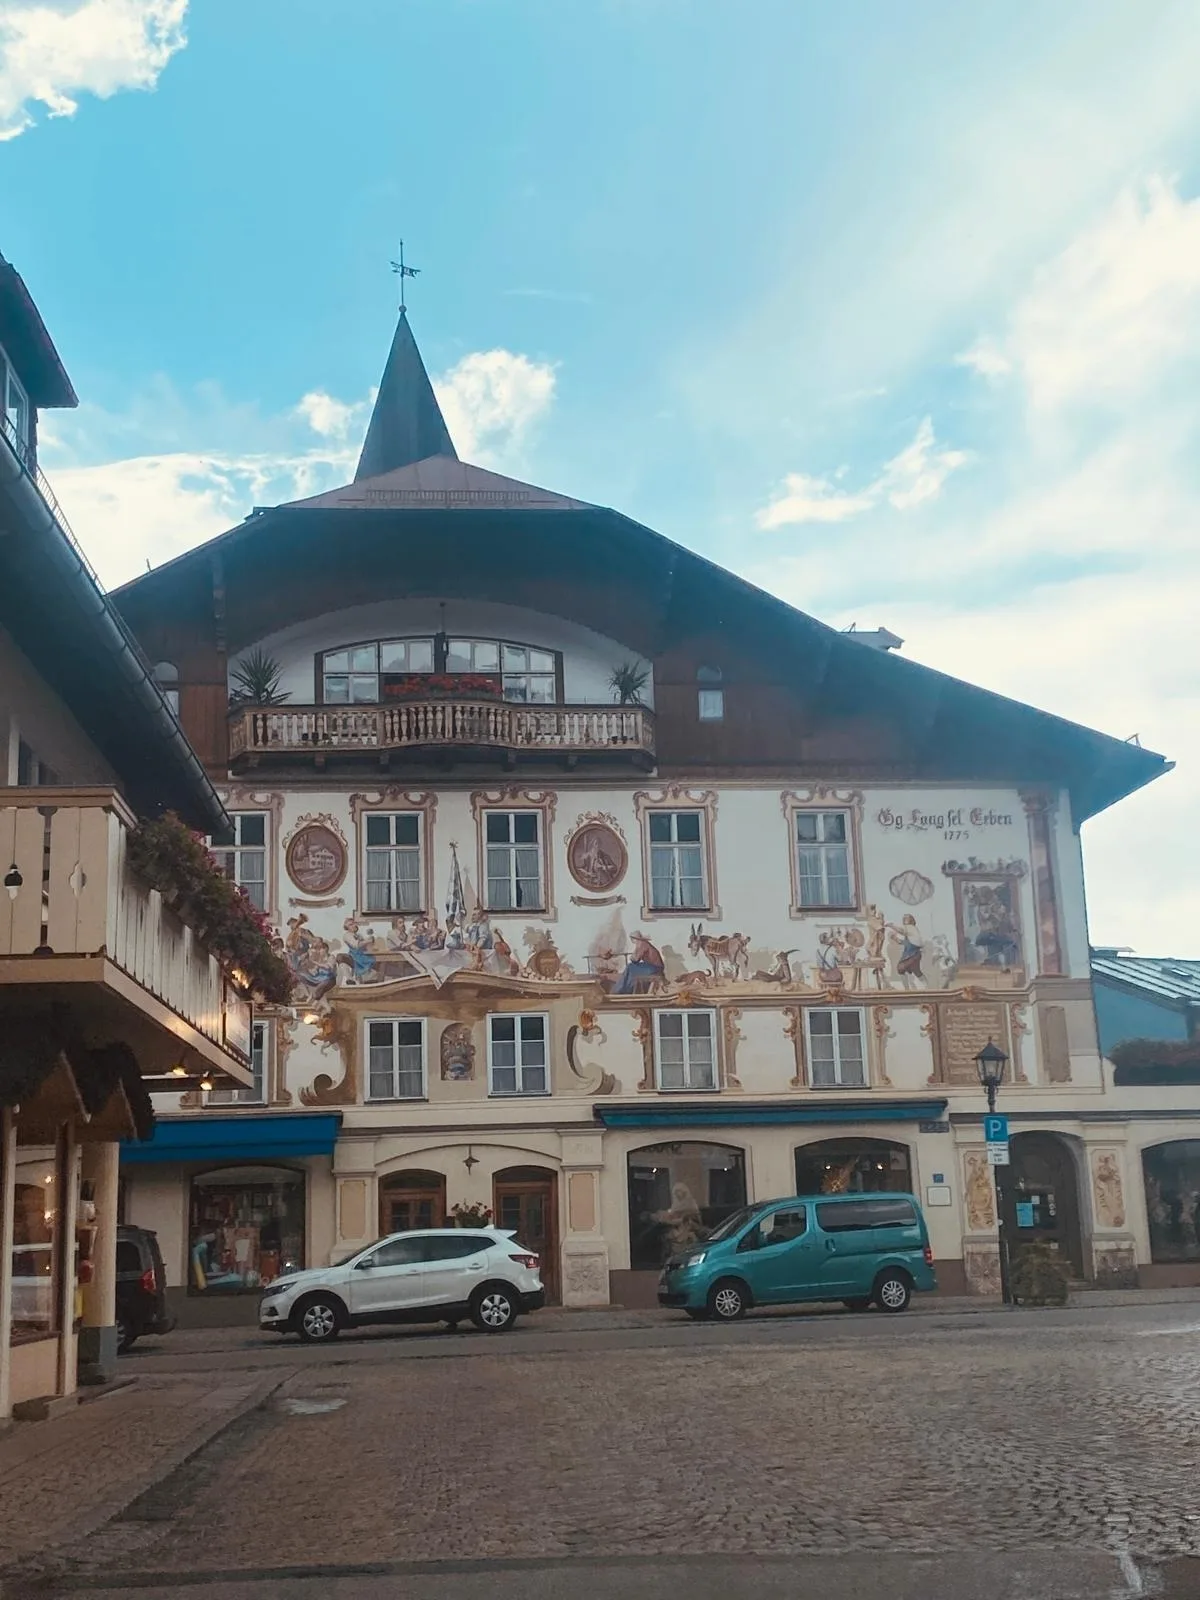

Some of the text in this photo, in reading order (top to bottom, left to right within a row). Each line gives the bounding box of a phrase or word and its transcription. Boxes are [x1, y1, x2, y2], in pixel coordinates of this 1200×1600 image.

[970, 808, 1012, 826] Erben
[944, 830, 969, 840] 1775
[990, 1119, 1001, 1138] P
